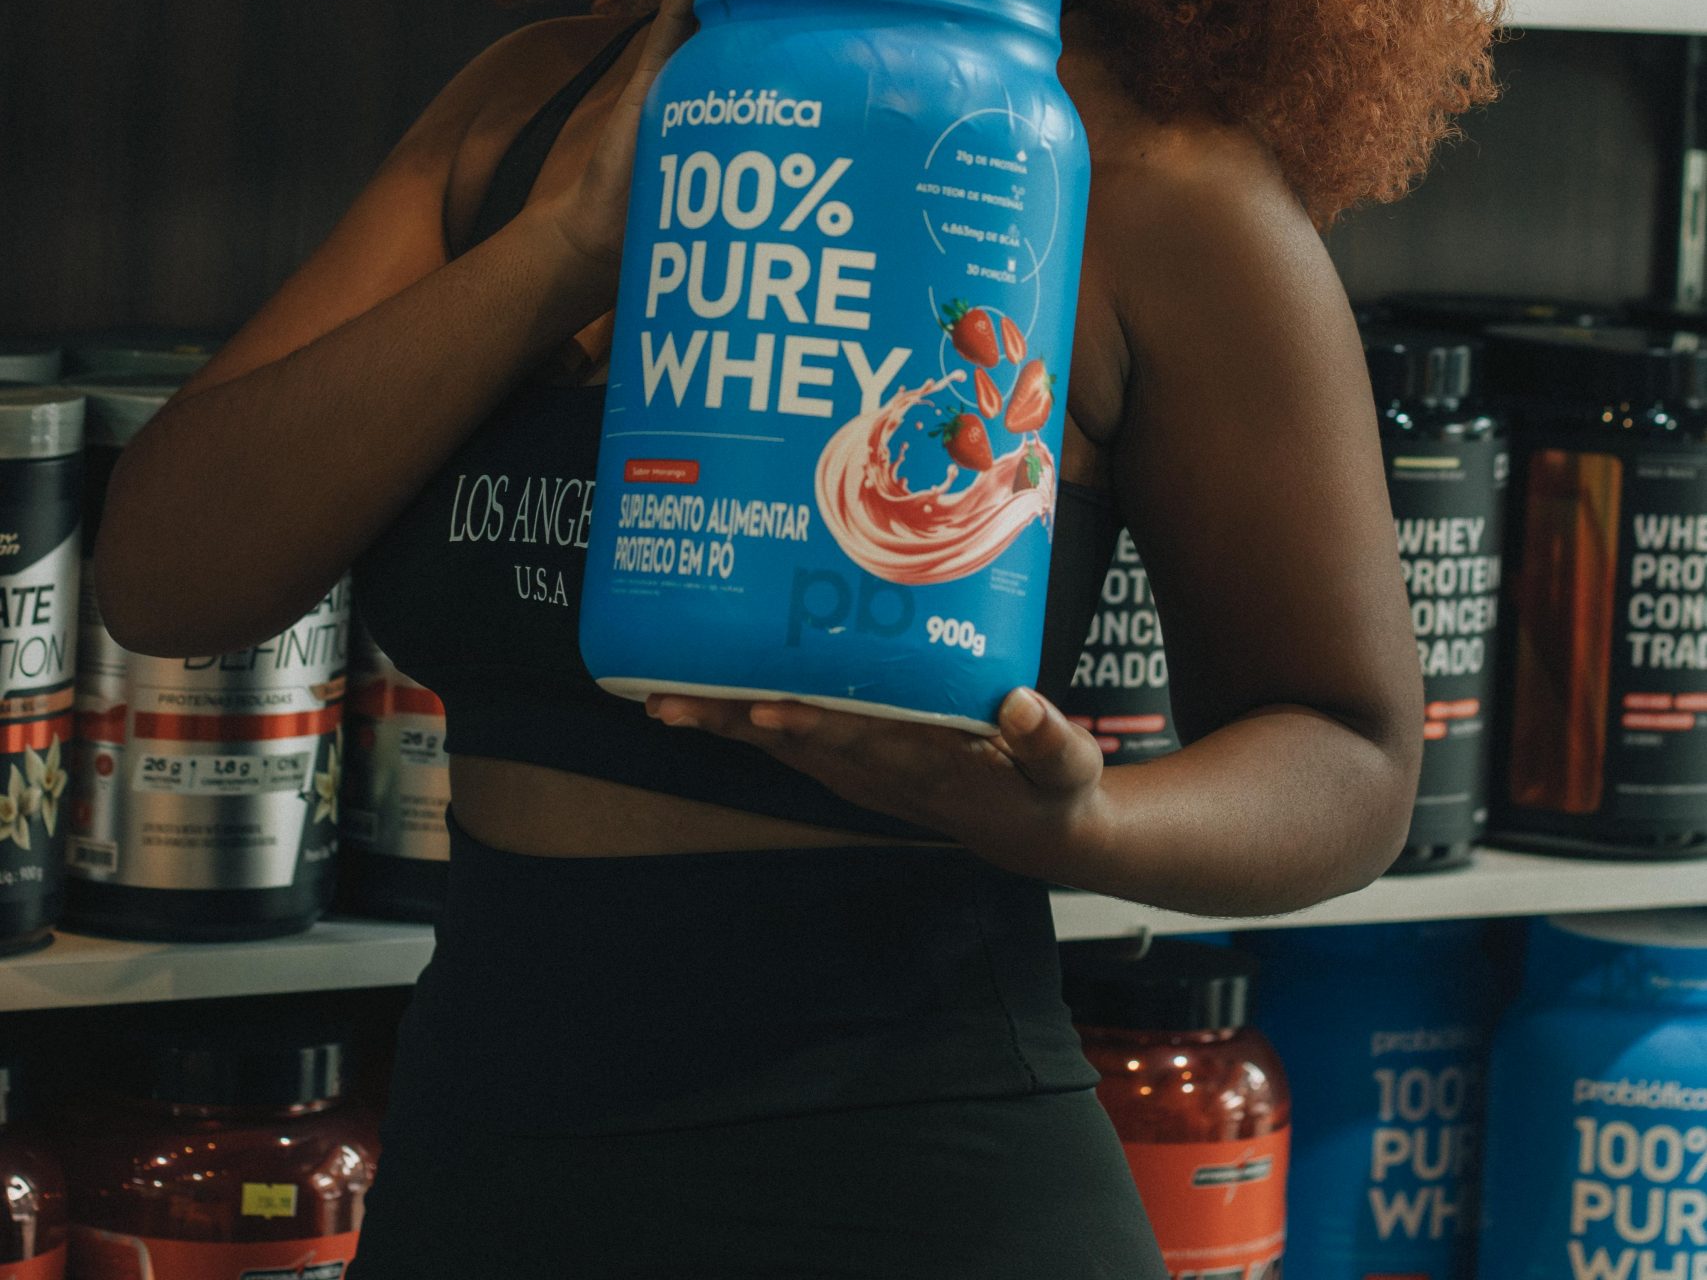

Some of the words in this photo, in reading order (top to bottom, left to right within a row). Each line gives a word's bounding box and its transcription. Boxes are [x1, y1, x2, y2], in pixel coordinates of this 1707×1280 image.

[661, 90, 823, 138] probiótica
[658, 150, 855, 238] 100%
[915, 182, 941, 195] ALTO
[942, 186, 966, 199] TEOR
[967, 190, 980, 202] DE
[645, 240, 878, 332] PURE
[640, 330, 913, 419] WHEY
[449, 474, 509, 542] LOS
[618, 493, 705, 533] SUPLEMENTO
[706, 497, 811, 542] ALIMENTAR
[613, 536, 676, 575] PROTEICO
[678, 538, 705, 576] EM
[706, 535, 735, 580] PÓ
[1394, 517, 1486, 555] WHEY
[514, 565, 569, 607] U.S.A
[1631, 552, 1707, 591] PRO
[926, 615, 987, 657] 900g
[1070, 651, 1169, 689] RADO
[143, 757, 167, 772] 26
[1570, 1179, 1707, 1246] PUR
